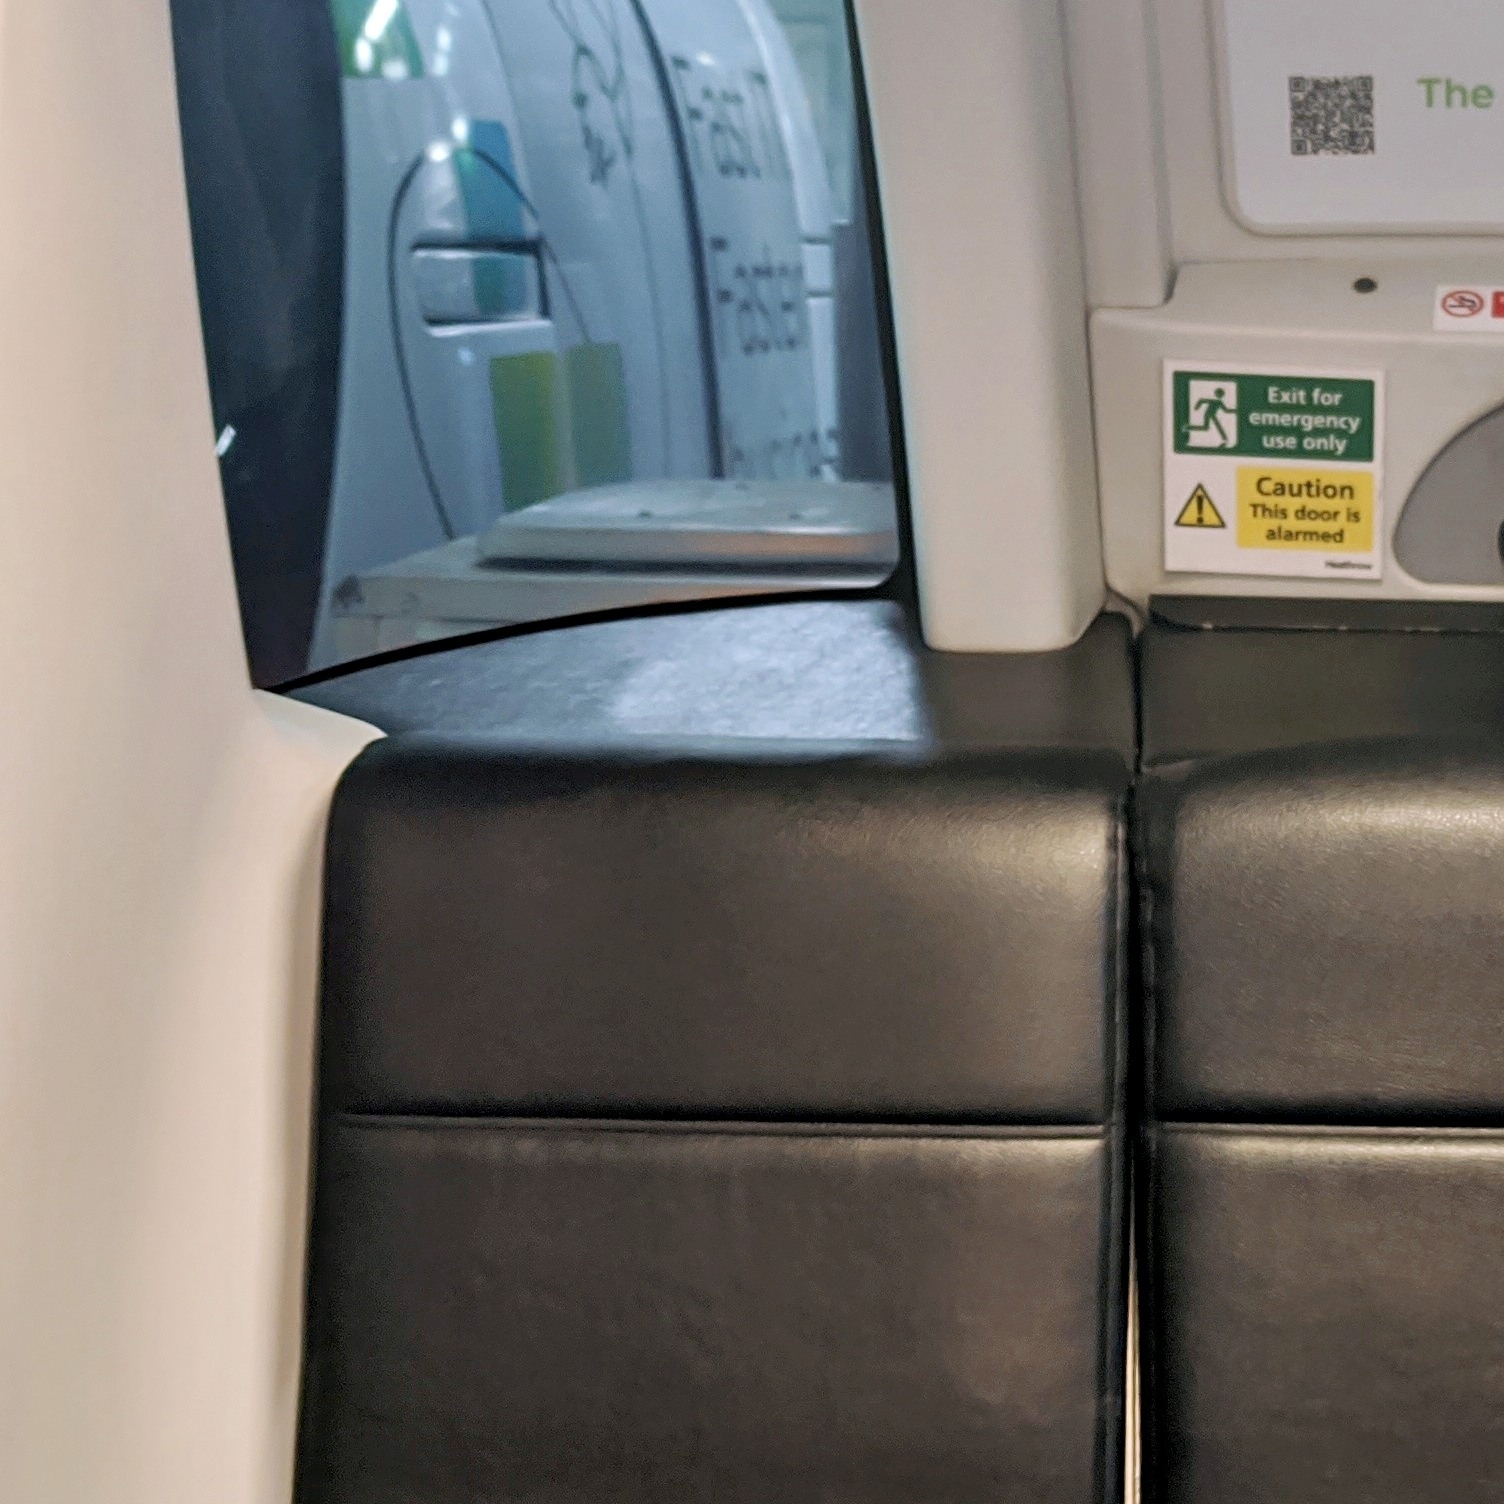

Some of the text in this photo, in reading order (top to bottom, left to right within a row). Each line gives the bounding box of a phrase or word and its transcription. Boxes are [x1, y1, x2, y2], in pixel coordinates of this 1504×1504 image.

[1416, 77, 1495, 109] The
[1268, 386, 1344, 405] Exit for
[1249, 410, 1362, 434] emergency
[1262, 433, 1348, 456] use only
[1256, 476, 1356, 500] Caution
[1250, 503, 1361, 523] This door is
[1265, 525, 1346, 544] alarmed
